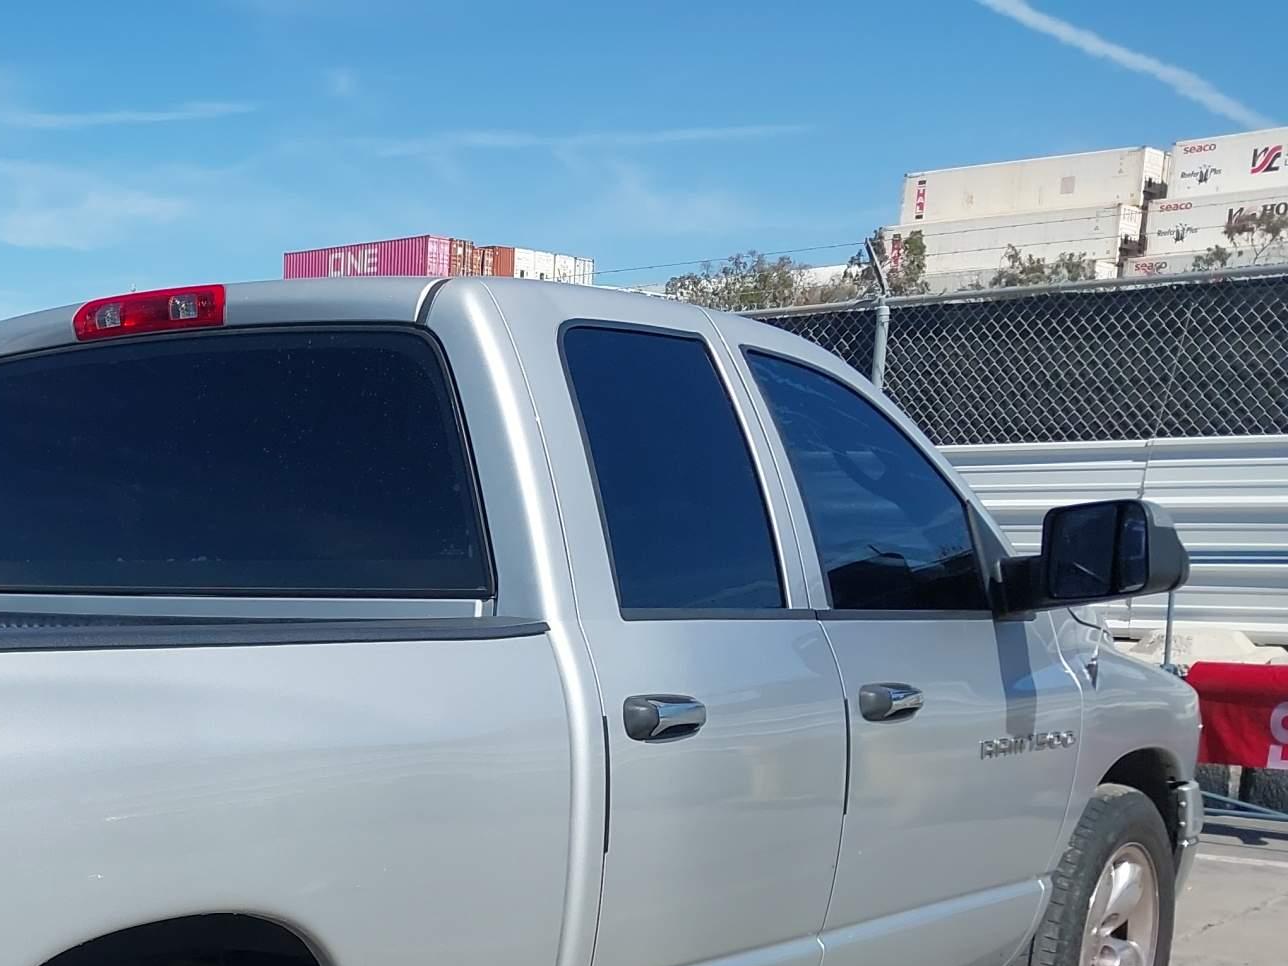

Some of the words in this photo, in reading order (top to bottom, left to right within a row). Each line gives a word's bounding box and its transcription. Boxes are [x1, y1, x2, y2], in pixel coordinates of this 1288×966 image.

[1183, 143, 1217, 154] seaco
[1160, 201, 1193, 212] seaco
[328, 247, 378, 278] ONE
